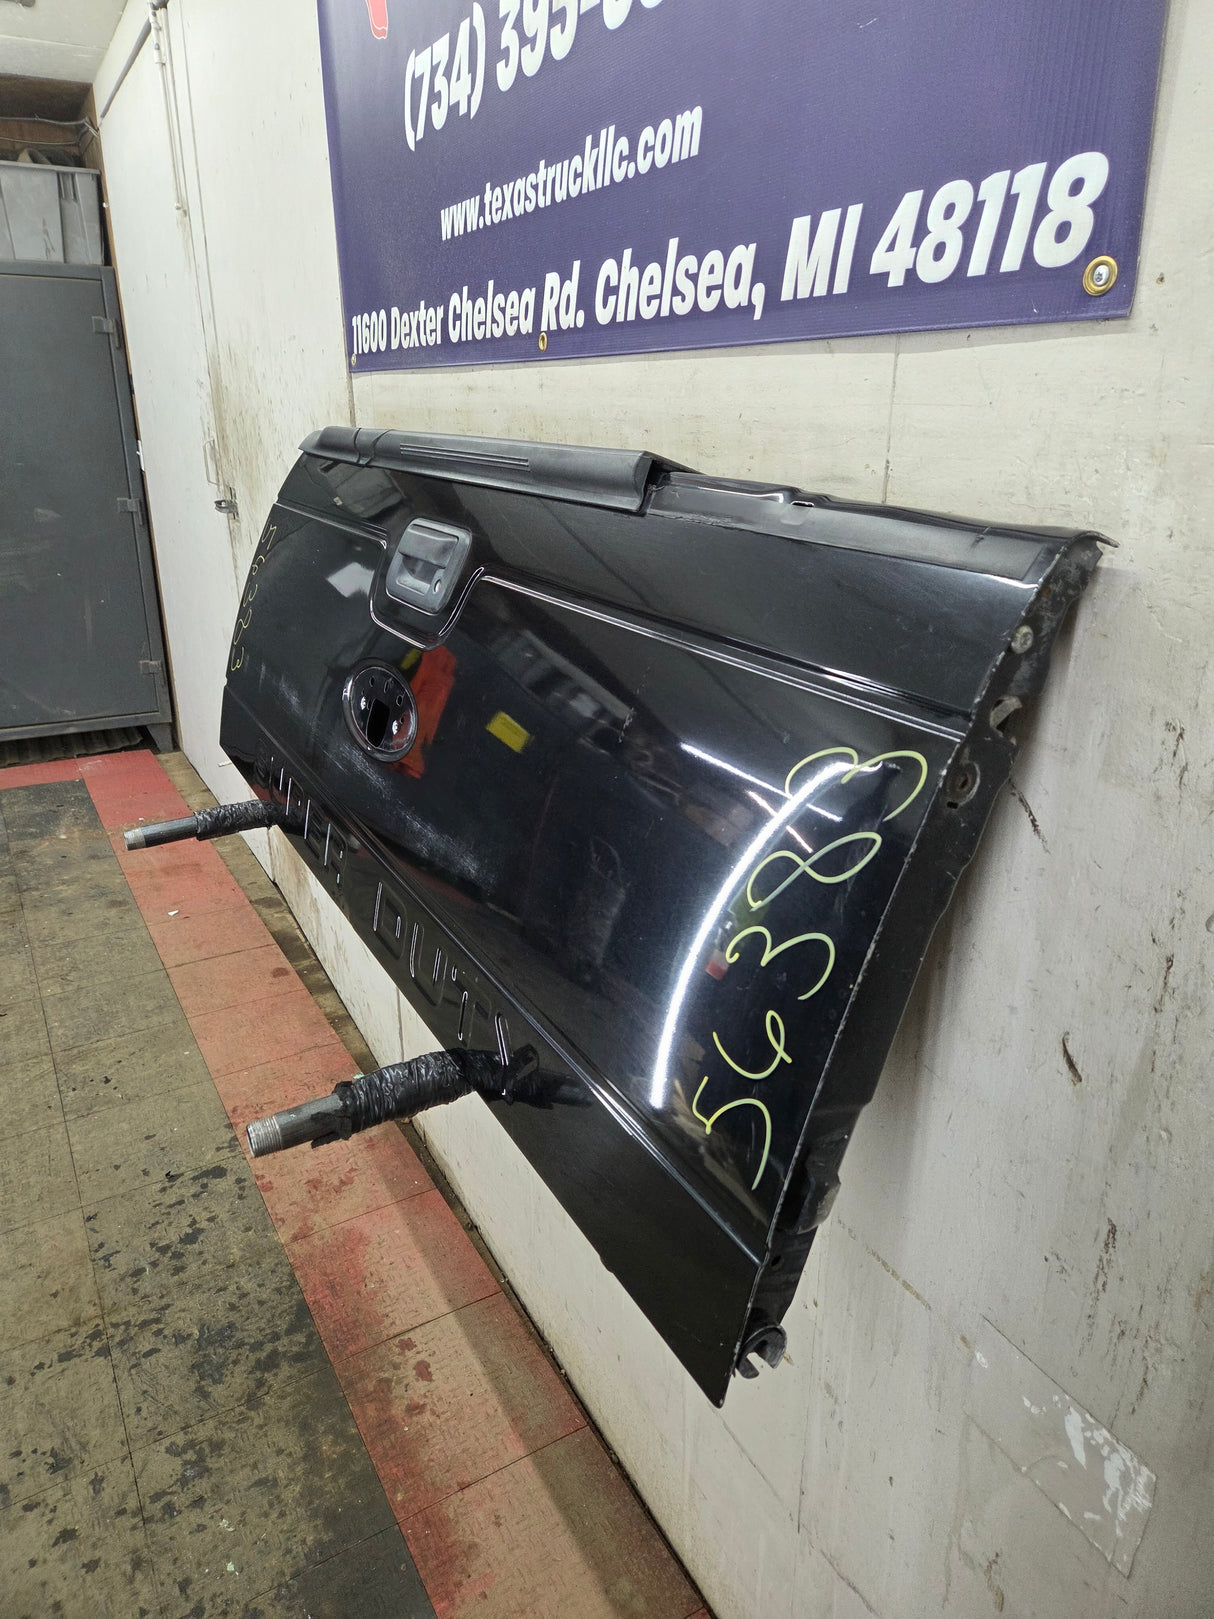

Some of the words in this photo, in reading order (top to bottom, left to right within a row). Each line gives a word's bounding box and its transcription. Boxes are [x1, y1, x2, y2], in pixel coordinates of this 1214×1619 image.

[404, 2, 486, 151] (734)
[496, 0, 663, 91] 395-
[351, 308, 388, 354] 11600
[390, 300, 444, 350] Dexter
[448, 280, 536, 342] Chelsea
[540, 259, 585, 332] Rd.
[594, 237, 766, 320] Chelsea,
[780, 203, 864, 301] MI
[869, 151, 1109, 287] 48118
[440, 105, 702, 241] www.texastruckllc.com
[692, 747, 928, 1190] 56383
